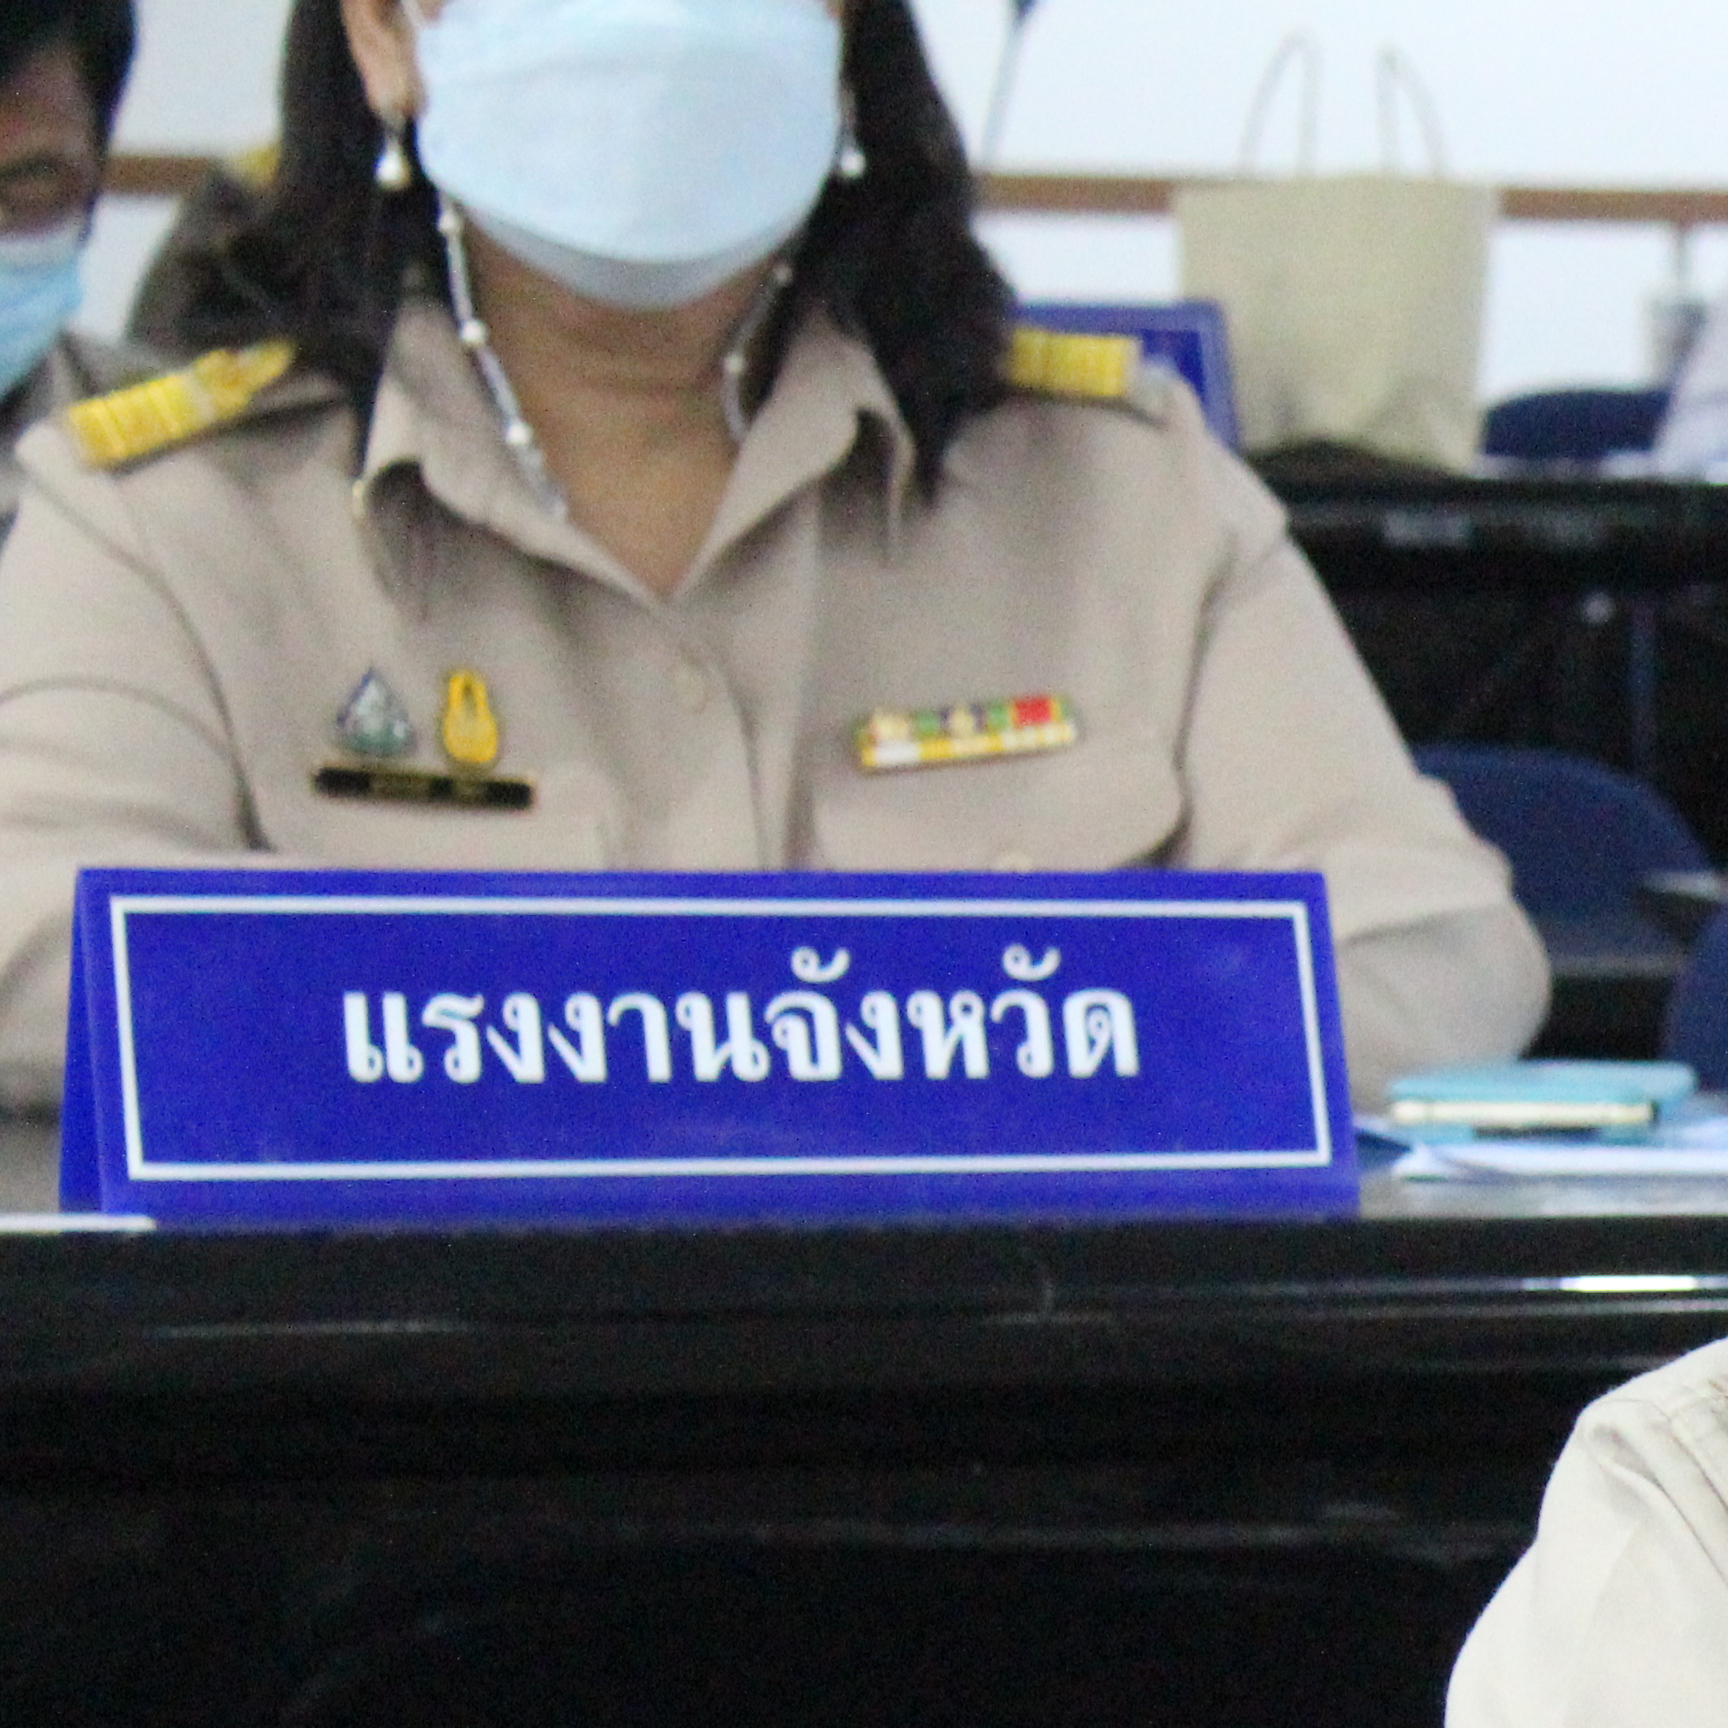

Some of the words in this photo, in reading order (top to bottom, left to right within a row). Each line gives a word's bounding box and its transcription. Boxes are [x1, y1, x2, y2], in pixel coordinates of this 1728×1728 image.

[342, 944, 1139, 1084] แรงงานจังหวัด
